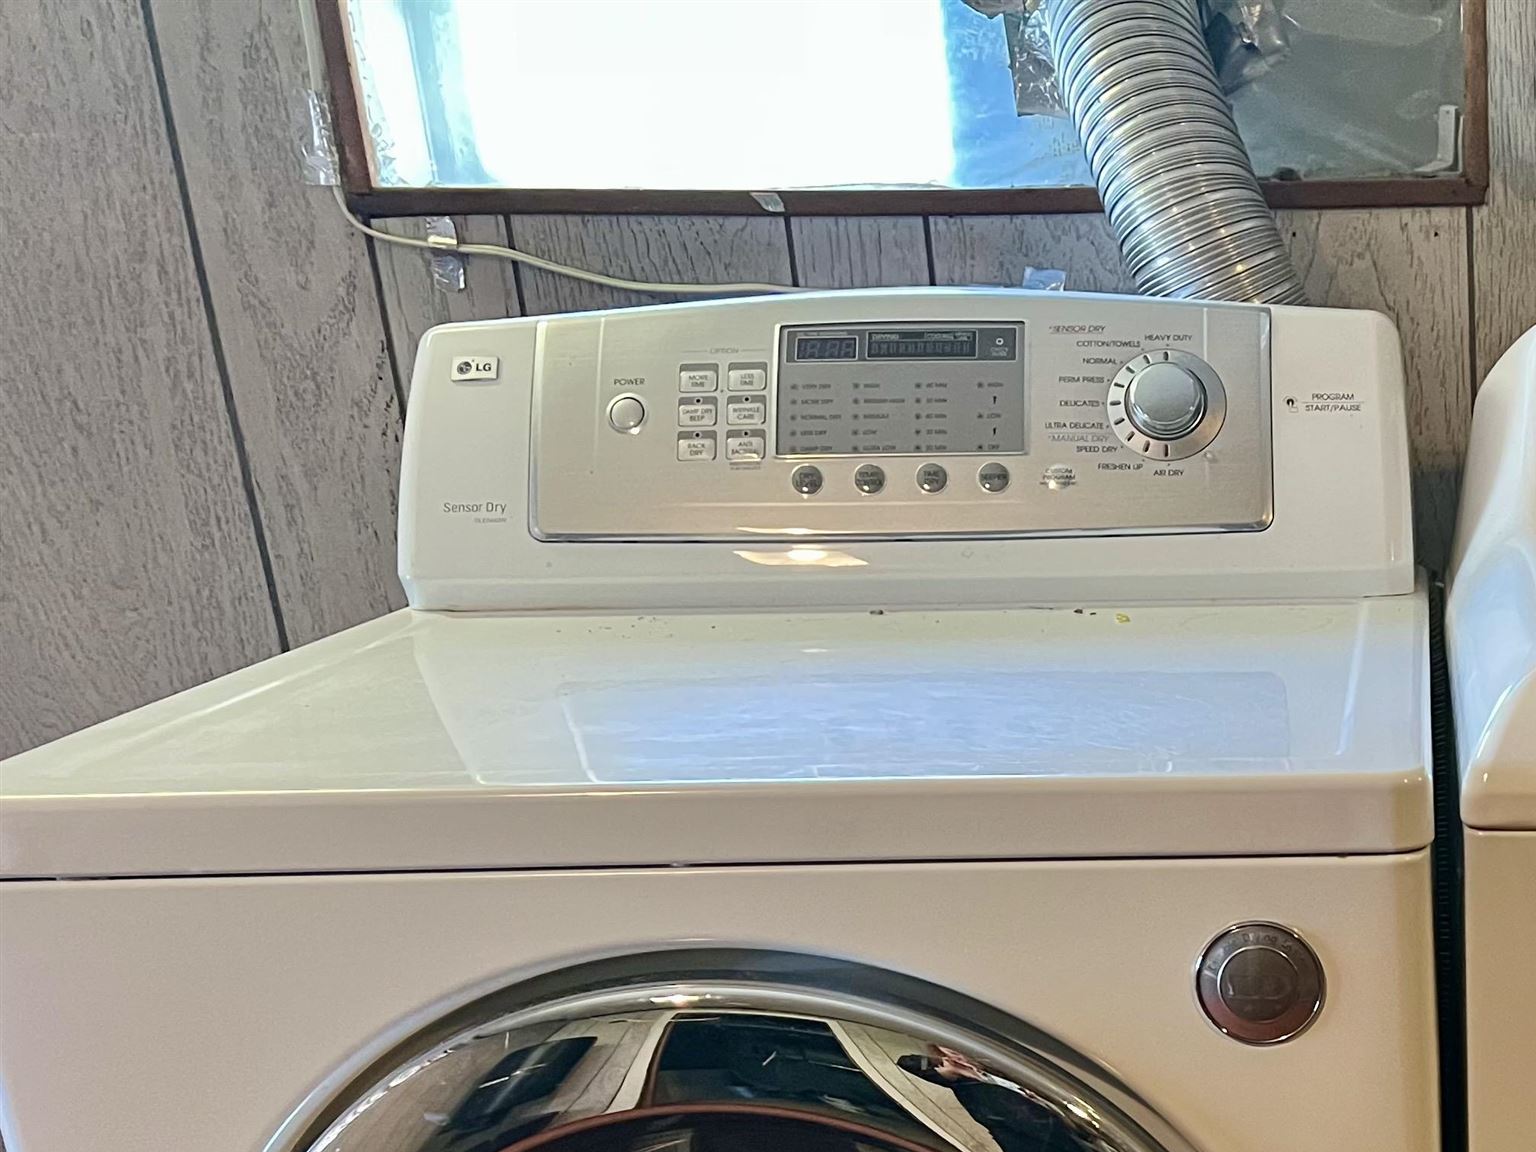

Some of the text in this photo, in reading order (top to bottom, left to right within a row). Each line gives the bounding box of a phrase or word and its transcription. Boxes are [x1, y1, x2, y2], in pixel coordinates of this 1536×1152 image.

[1088, 325, 1106, 333] DRY
[1076, 340, 1141, 348] COTTON/TOWELS
[475, 363, 492, 372] LG
[613, 378, 645, 387] POWER
[1059, 376, 1104, 384] PERM PRESS
[1312, 393, 1354, 401] PROGRAM
[1305, 404, 1361, 412] START/PAUSE
[1069, 422, 1104, 430] DELICATE
[443, 502, 507, 514] Sensor Dry
